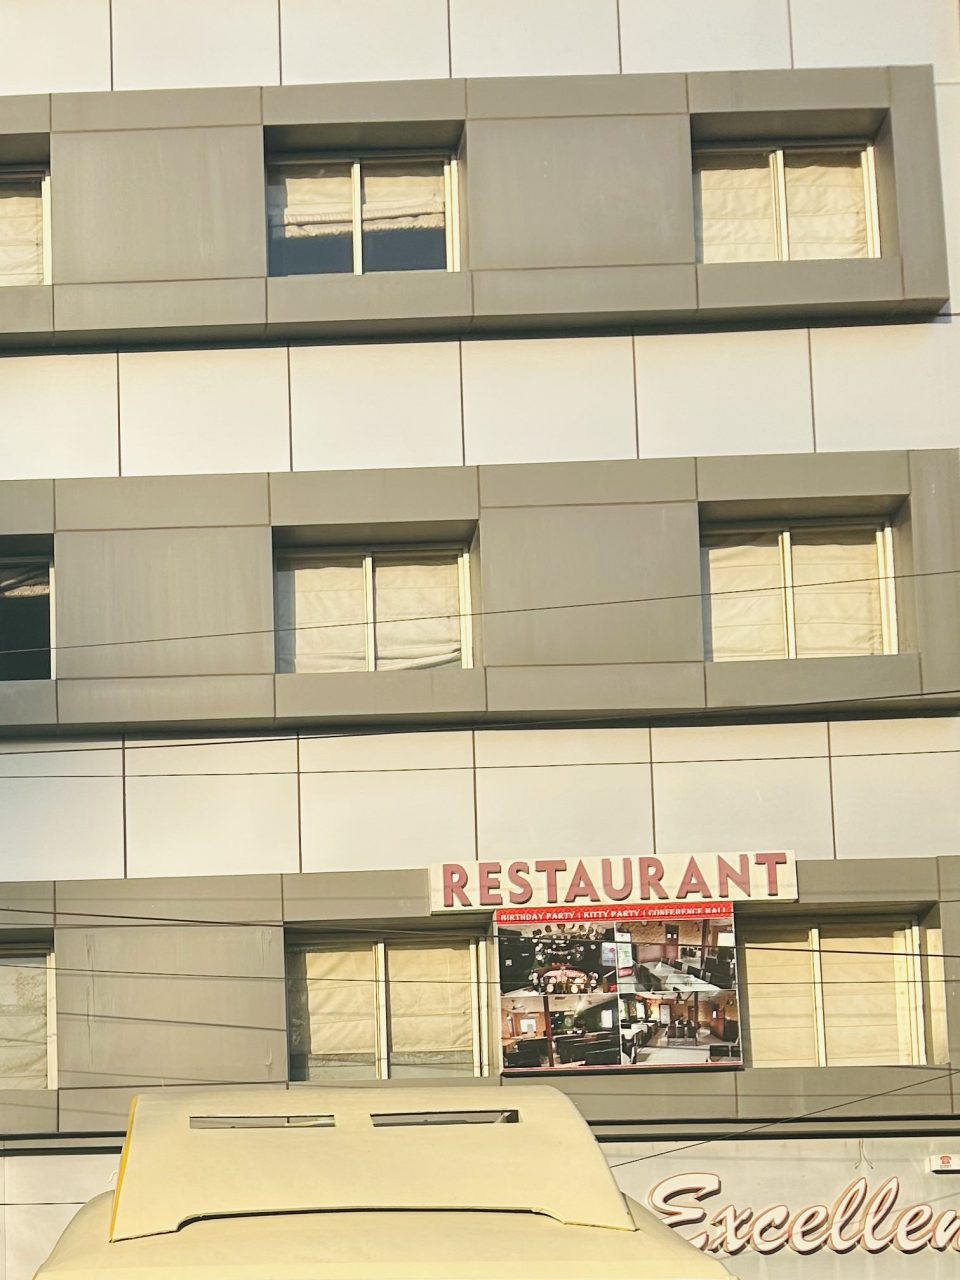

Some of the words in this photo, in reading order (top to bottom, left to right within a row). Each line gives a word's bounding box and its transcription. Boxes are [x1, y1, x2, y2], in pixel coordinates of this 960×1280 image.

[442, 852, 786, 908] RESTAURANT
[500, 911, 543, 922] BIRTHDAY
[546, 910, 575, 921] PARTY
[583, 909, 608, 919] KITTY
[611, 908, 641, 918] PARTY
[648, 907, 703, 917] CONFERENCE
